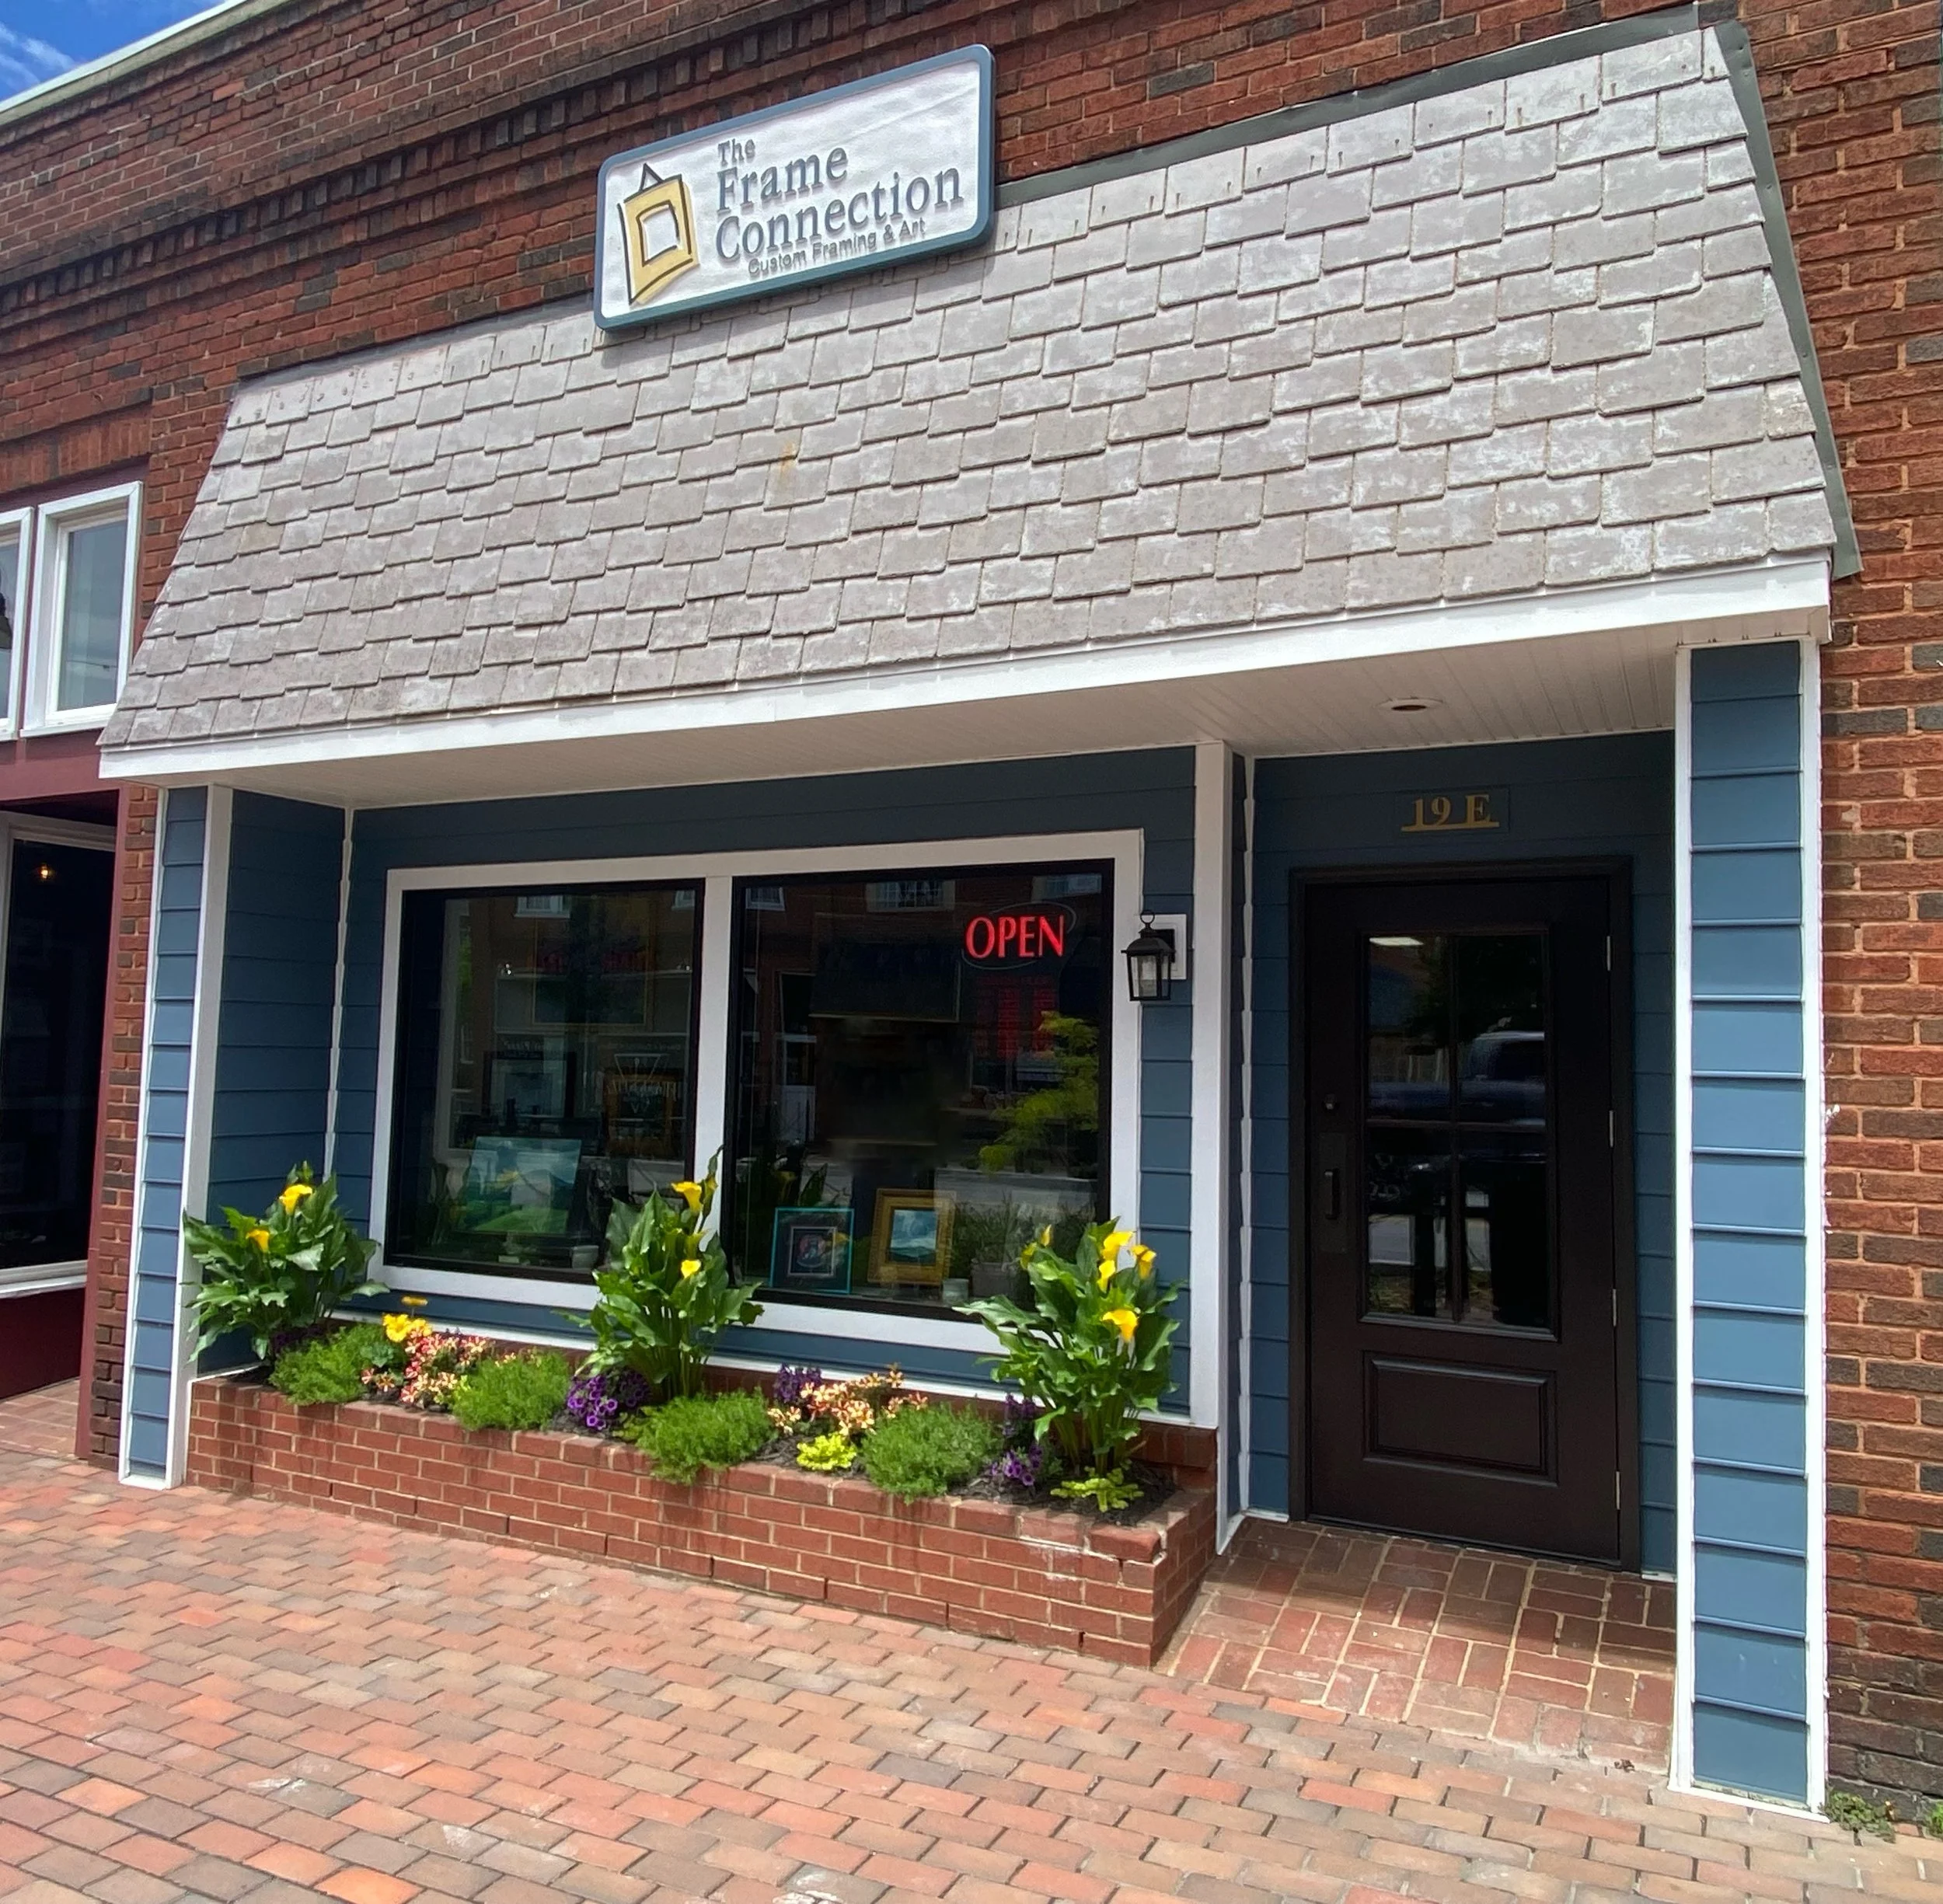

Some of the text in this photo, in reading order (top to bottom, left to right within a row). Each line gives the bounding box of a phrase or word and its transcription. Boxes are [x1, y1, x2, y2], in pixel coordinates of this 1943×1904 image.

[717, 138, 755, 166] The
[717, 147, 849, 214] Frame
[716, 166, 964, 262] Connection
[748, 217, 926, 277] Custom Framing & Art
[1413, 793, 1491, 827] 19 E
[965, 915, 1065, 959] OPEN
